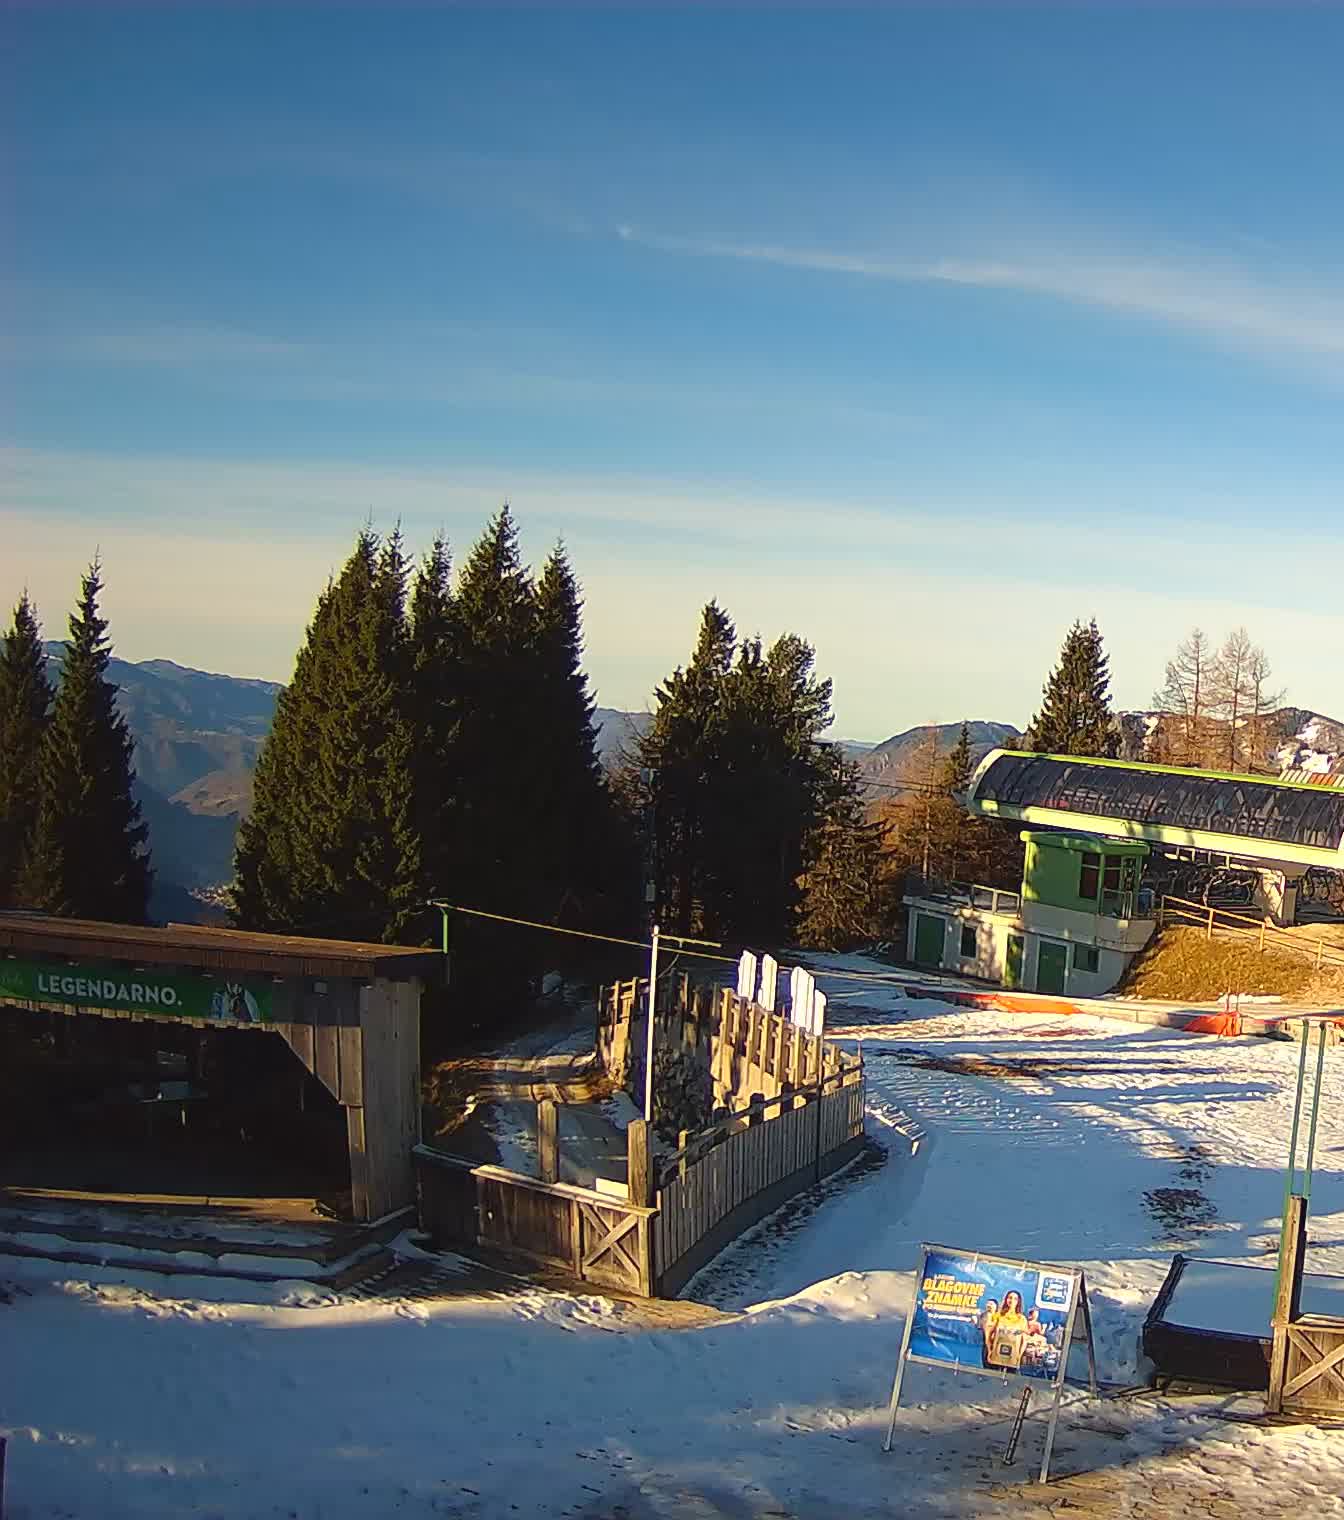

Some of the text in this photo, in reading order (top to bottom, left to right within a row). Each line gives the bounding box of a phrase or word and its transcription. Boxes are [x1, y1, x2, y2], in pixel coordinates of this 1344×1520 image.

[38, 974, 183, 1006] LEGENDARNO.
[924, 1279, 985, 1295] BLAGOVNE
[925, 1291, 978, 1307] ZNAMKE
